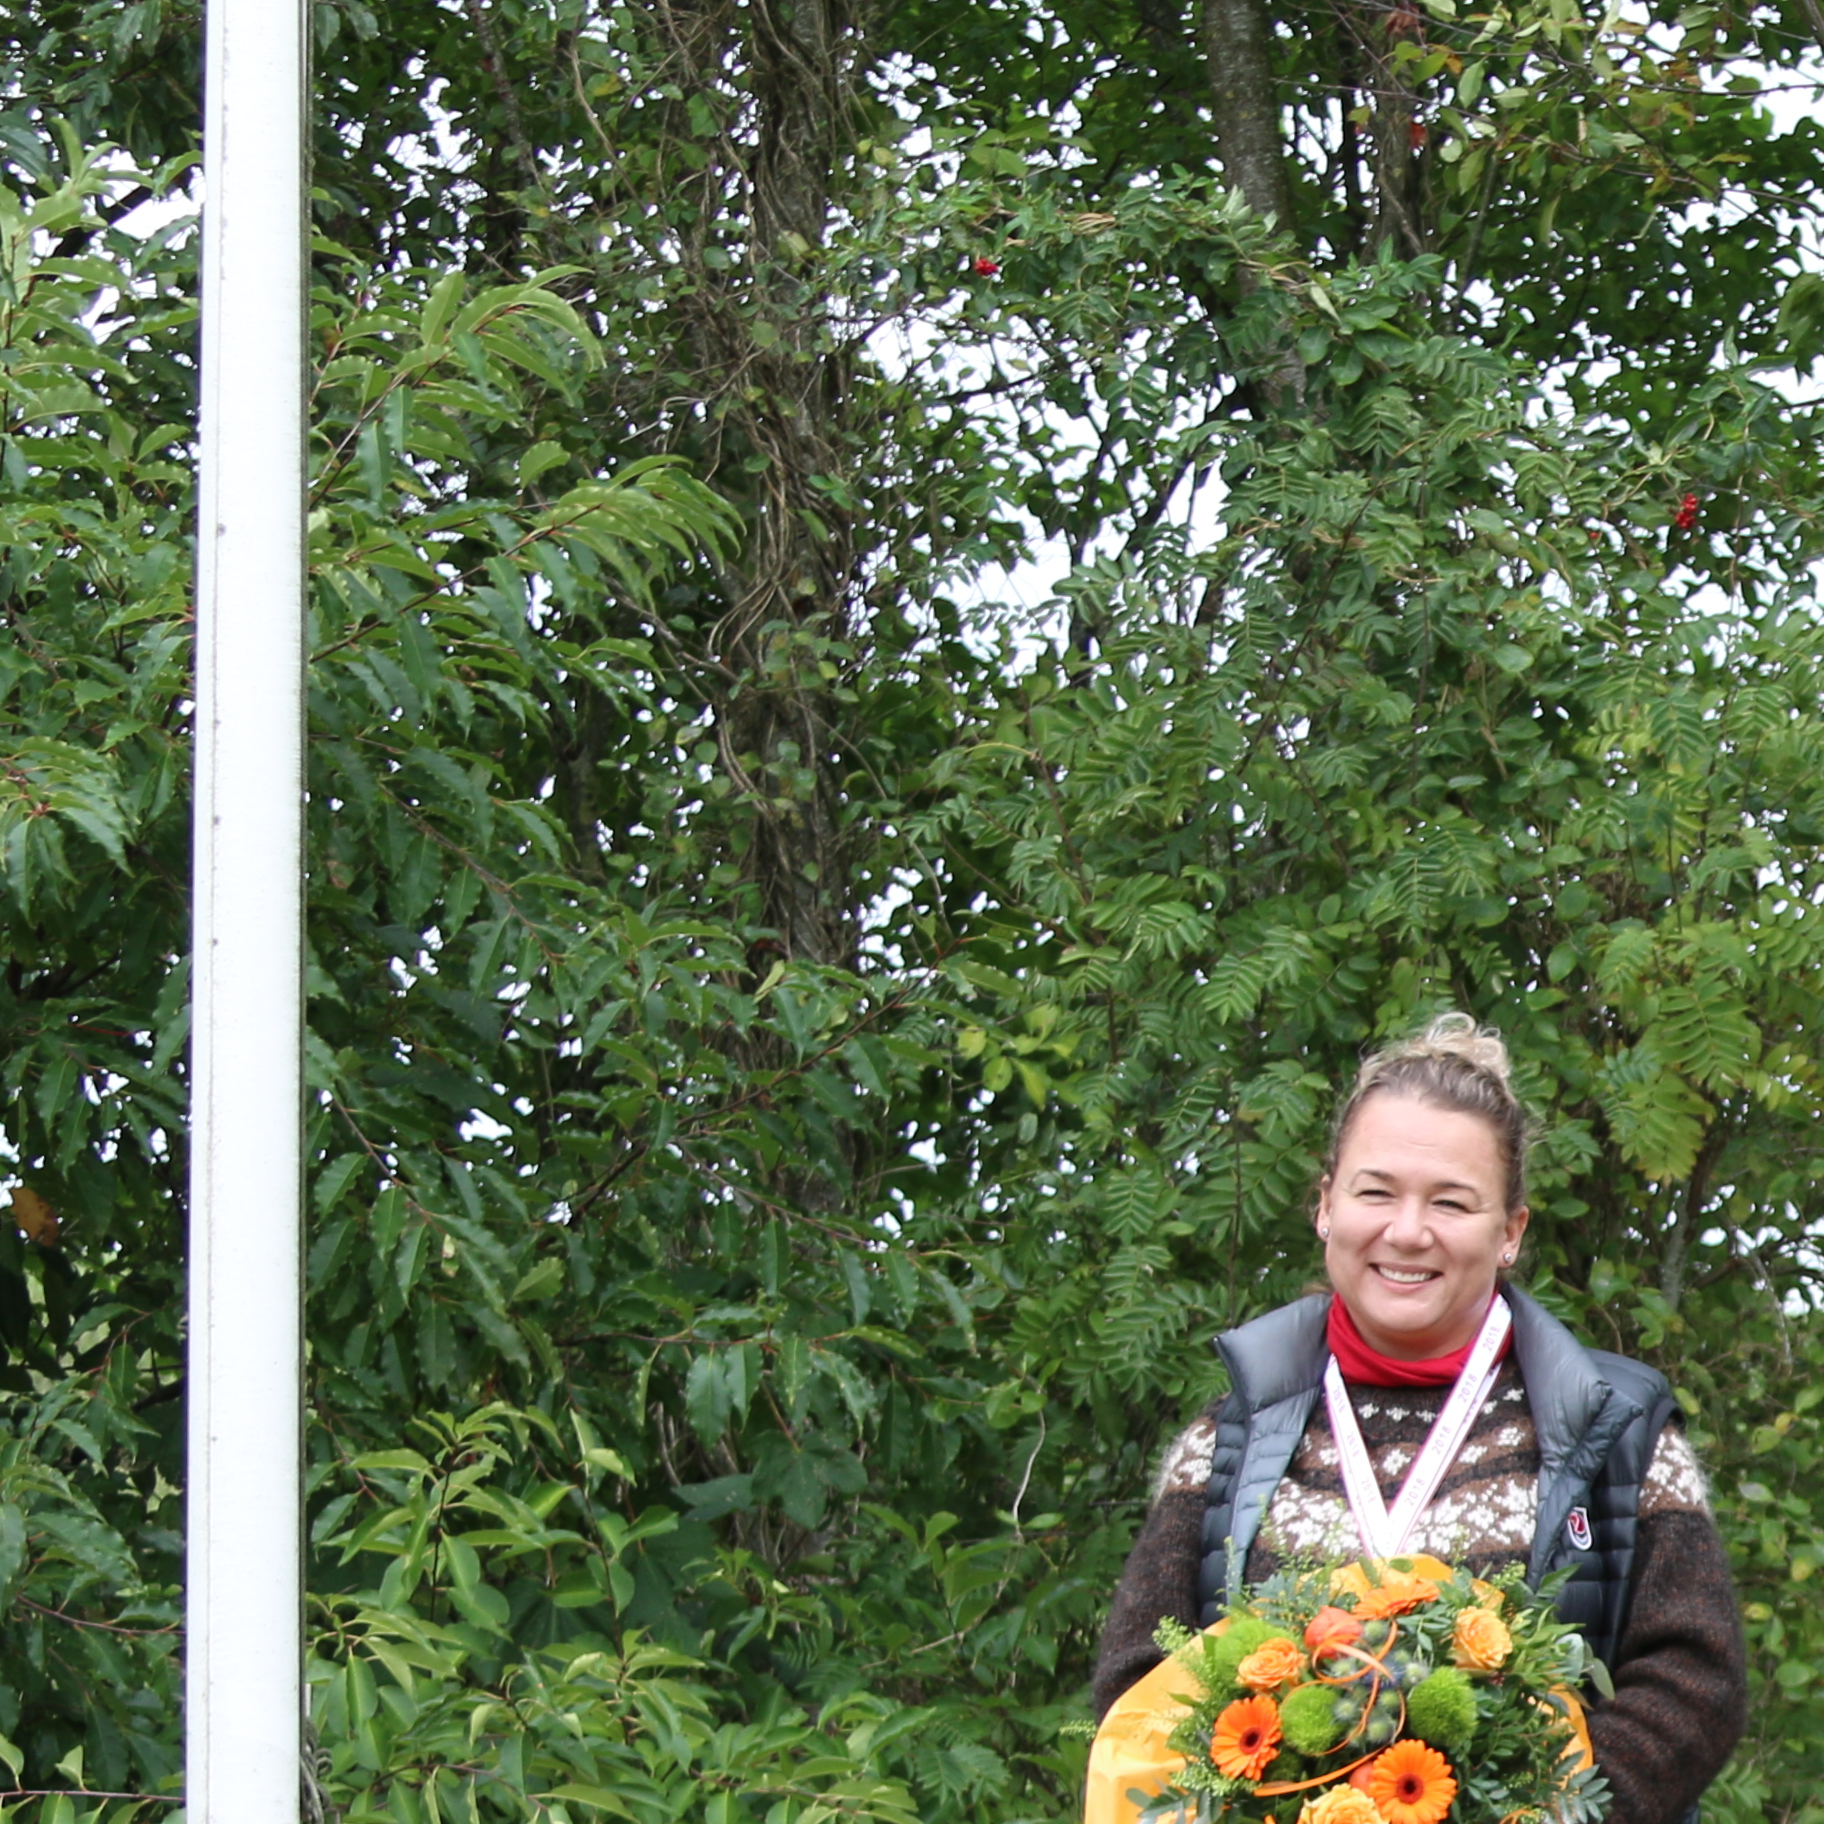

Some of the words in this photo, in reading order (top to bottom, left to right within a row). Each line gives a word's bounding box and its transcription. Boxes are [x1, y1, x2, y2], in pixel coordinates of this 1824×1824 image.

[1405, 1477, 1426, 1507] 2018
[1432, 1425, 1452, 1455] 2018
[1458, 1373, 1477, 1403] 2018
[1482, 1325, 1501, 1353] 2018
[1361, 1477, 1377, 1504] 2018
